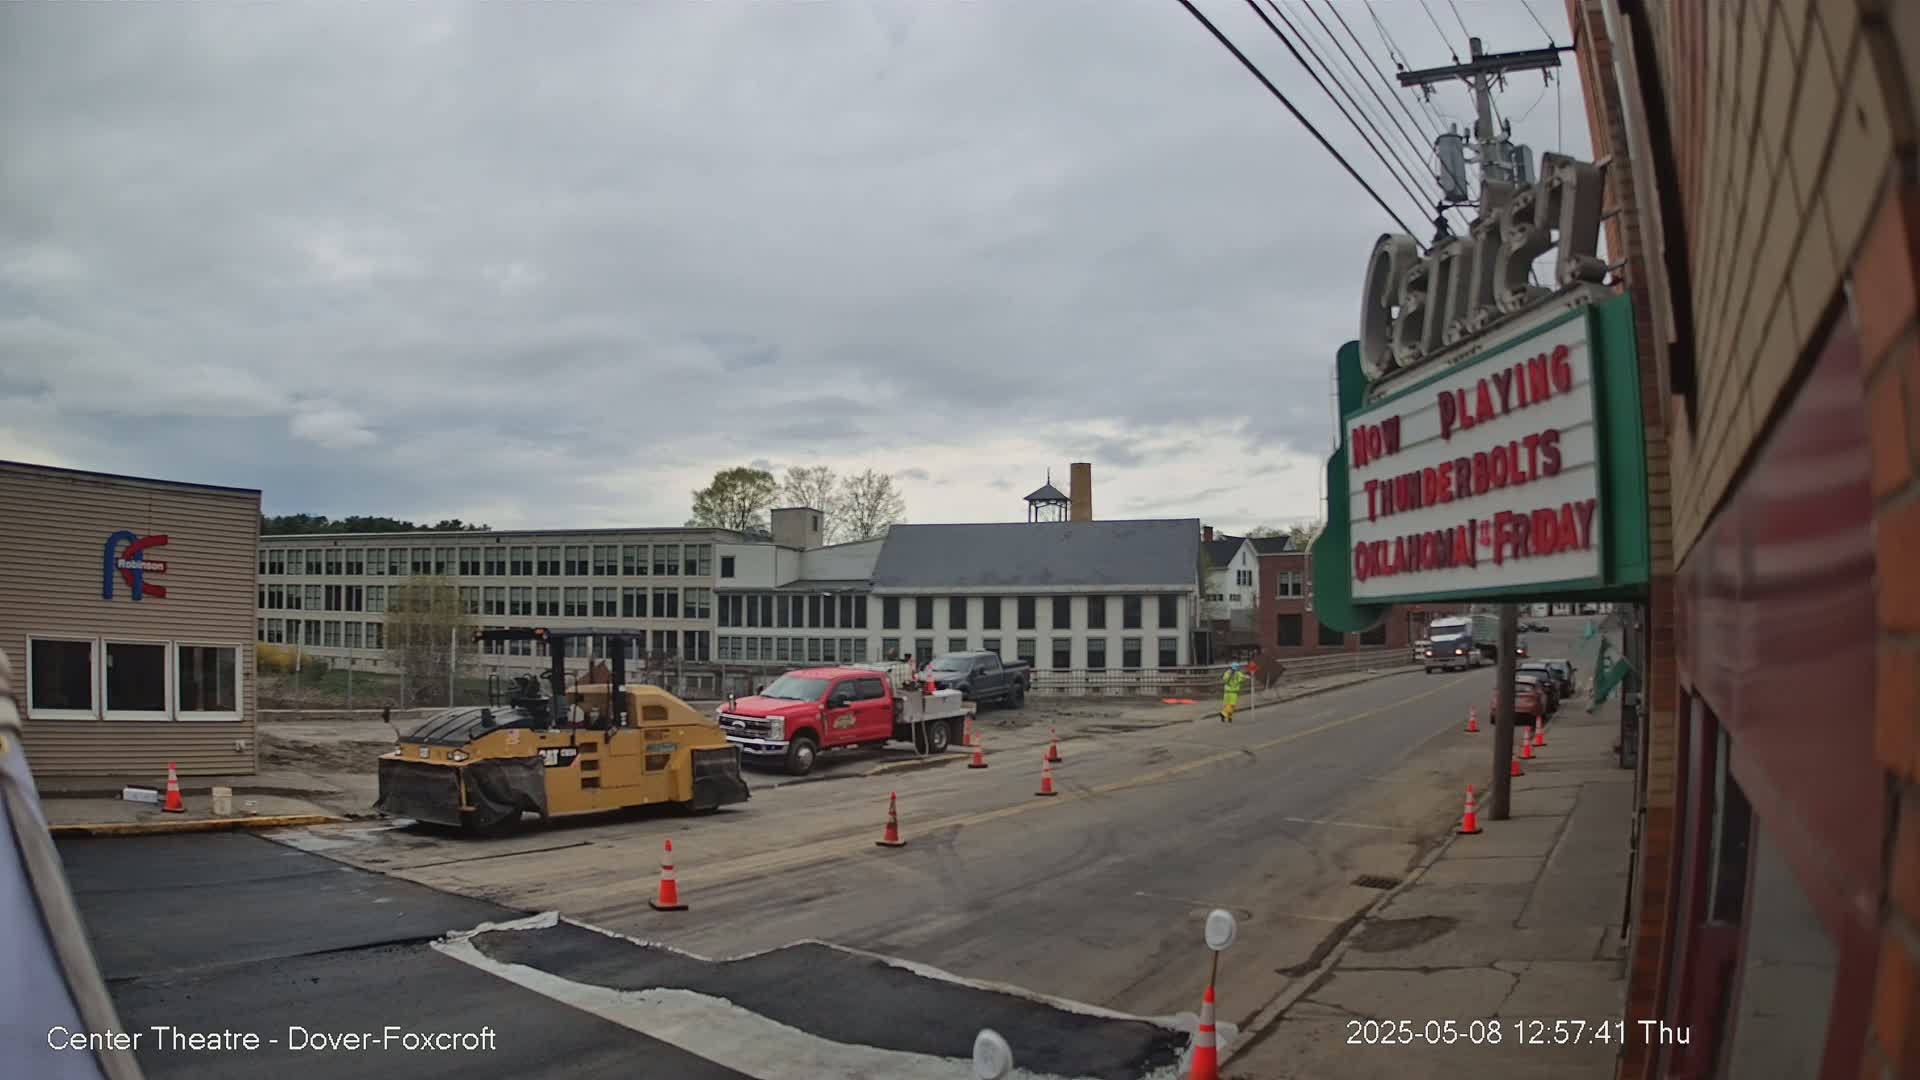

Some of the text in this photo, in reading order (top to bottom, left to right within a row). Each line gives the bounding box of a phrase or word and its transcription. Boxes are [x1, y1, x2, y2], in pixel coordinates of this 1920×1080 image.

[1359, 150, 1608, 382] Center
[1351, 344, 1572, 469] NOW PLAYING
[1364, 428, 1562, 522] THUNDERBOLTS
[1493, 498, 1596, 567] FRIDAY
